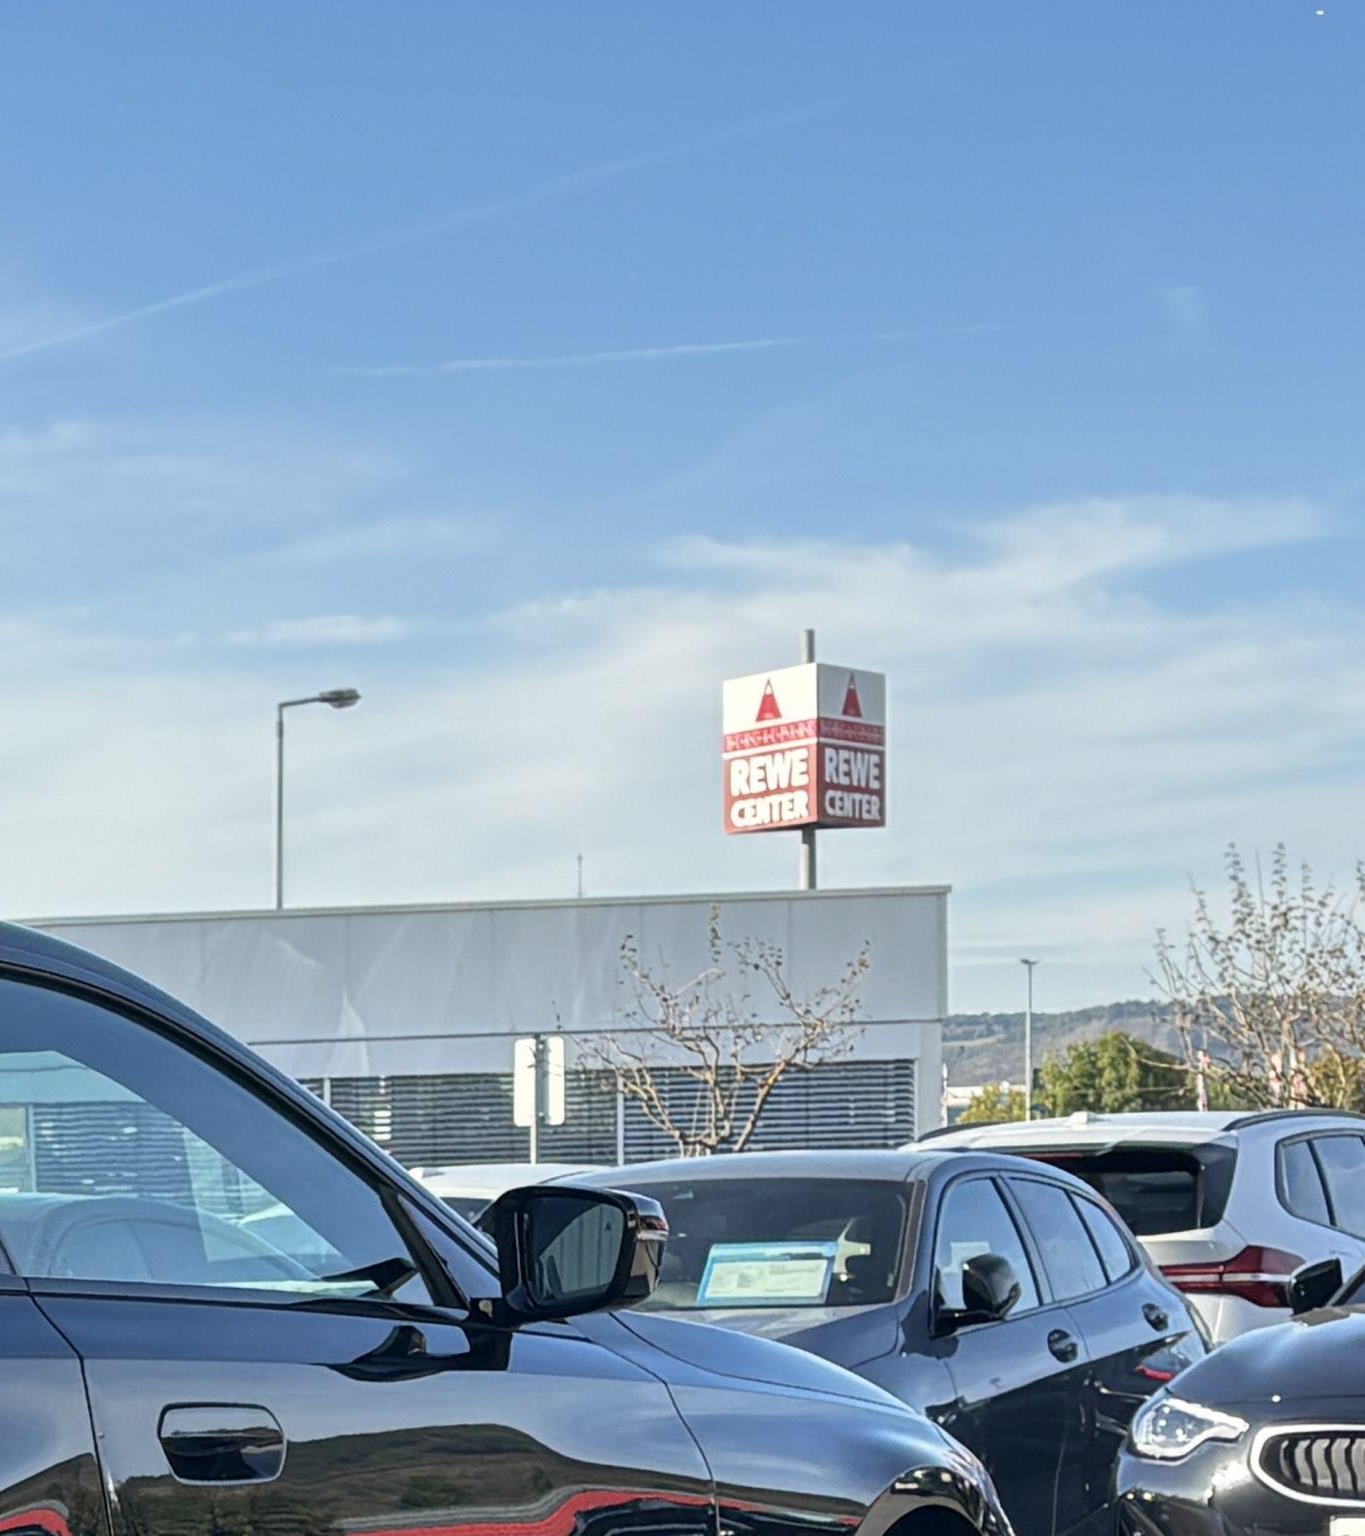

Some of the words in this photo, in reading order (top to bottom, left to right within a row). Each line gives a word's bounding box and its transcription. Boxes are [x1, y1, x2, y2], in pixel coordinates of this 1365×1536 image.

[730, 748, 809, 797] REWE
[825, 748, 881, 789] REWE
[730, 790, 809, 828] CENTER
[825, 790, 881, 821] CENTER
